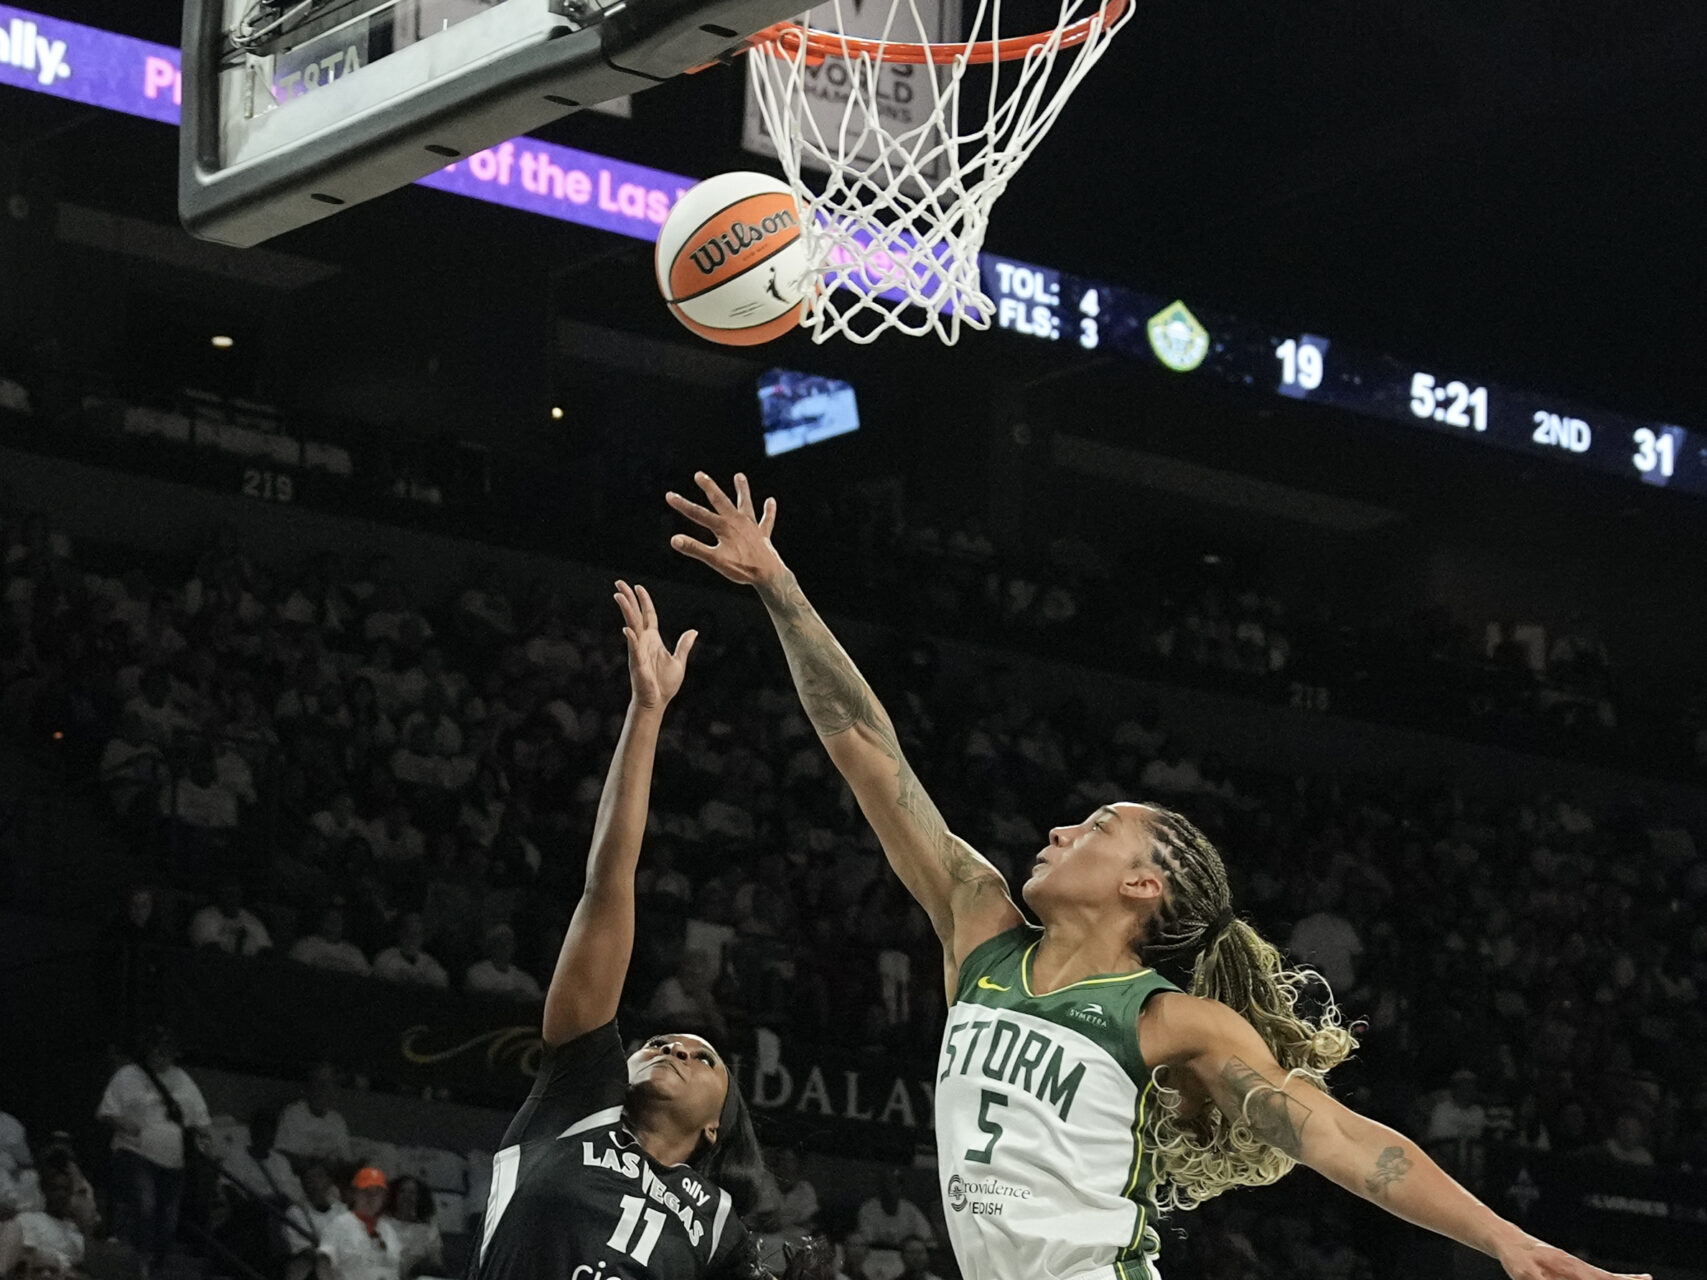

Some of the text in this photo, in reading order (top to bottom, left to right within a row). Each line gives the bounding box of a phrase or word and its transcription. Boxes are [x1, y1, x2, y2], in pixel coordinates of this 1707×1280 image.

[468, 141, 670, 224] of the Las
[689, 209, 798, 275] Wilson
[995, 262, 1100, 318] TOL: 4
[999, 297, 1099, 350] FLS: 3
[1275, 338, 1324, 390] 19
[1410, 371, 1489, 432] 5:21
[1532, 410, 1592, 453] 2ND
[1632, 426, 1675, 477] 31
[1068, 1007, 1107, 1029] SYMETRA
[939, 1019, 1087, 1124] STORM
[964, 1088, 1009, 1165] 5
[582, 1141, 705, 1247] LAS VEGAS
[681, 1177, 711, 1207] ally
[962, 1179, 1032, 1200] rovidence
[606, 1194, 667, 1267] 11
